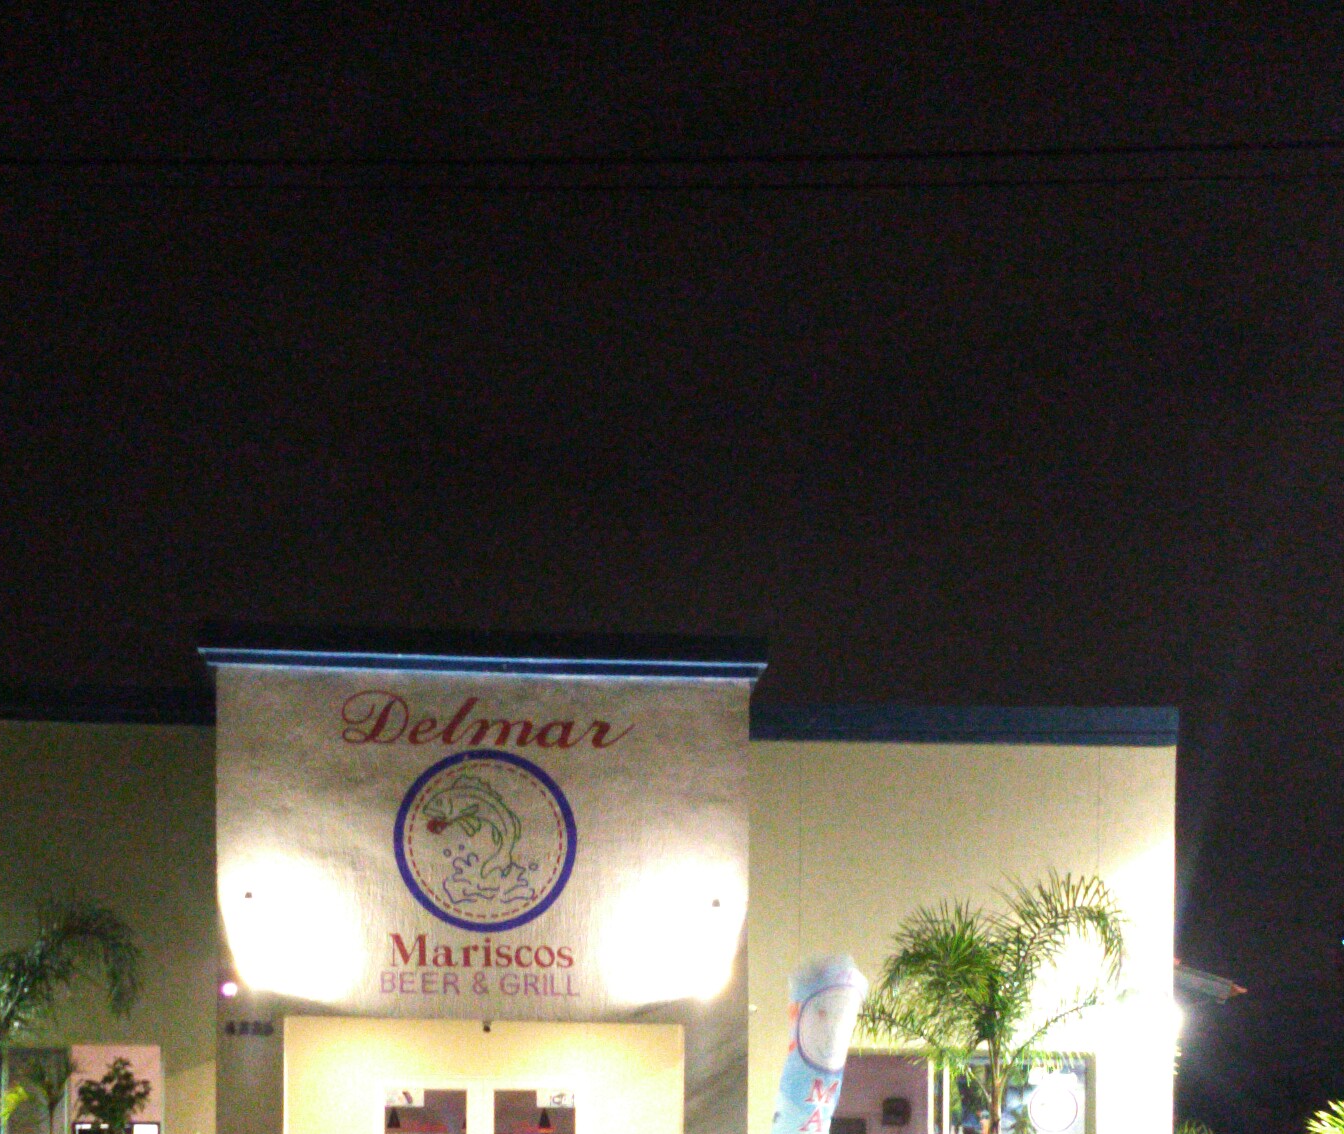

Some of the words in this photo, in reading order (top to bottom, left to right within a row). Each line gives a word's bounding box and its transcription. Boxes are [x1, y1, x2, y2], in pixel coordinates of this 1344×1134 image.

[340, 688, 635, 749] Delmar
[390, 932, 574, 968] Mariscos
[380, 970, 460, 995] BEER
[472, 970, 489, 995] &
[499, 971, 580, 997] GRILL
